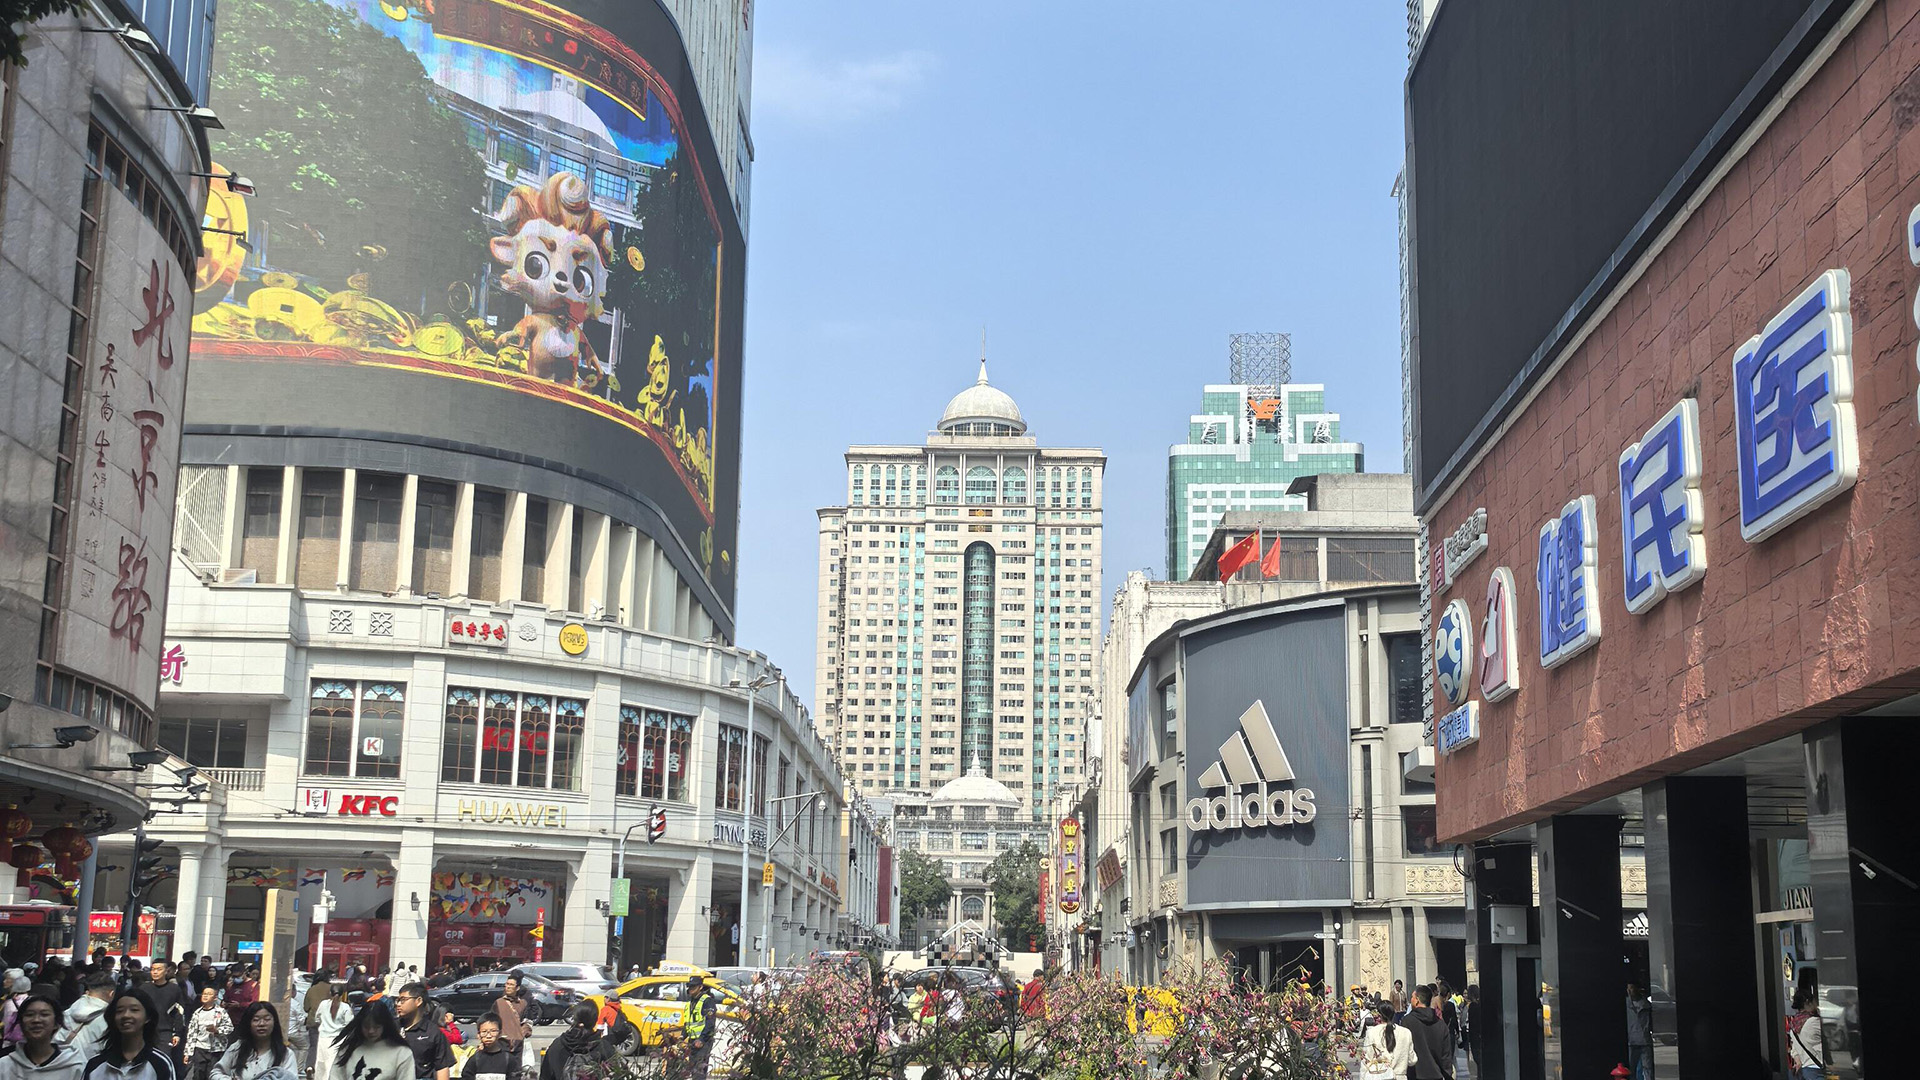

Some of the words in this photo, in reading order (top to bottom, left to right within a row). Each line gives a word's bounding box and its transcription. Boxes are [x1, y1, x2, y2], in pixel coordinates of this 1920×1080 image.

[1538, 225, 1920, 660] 健民医
[110, 259, 175, 653] 北京路
[367, 739, 378, 752] K
[338, 794, 399, 816] KFC
[458, 799, 567, 828] HUAWEI
[1184, 783, 1317, 832] adidas
[1783, 886, 1813, 910] JIAN
[444, 930, 465, 940] GPR
